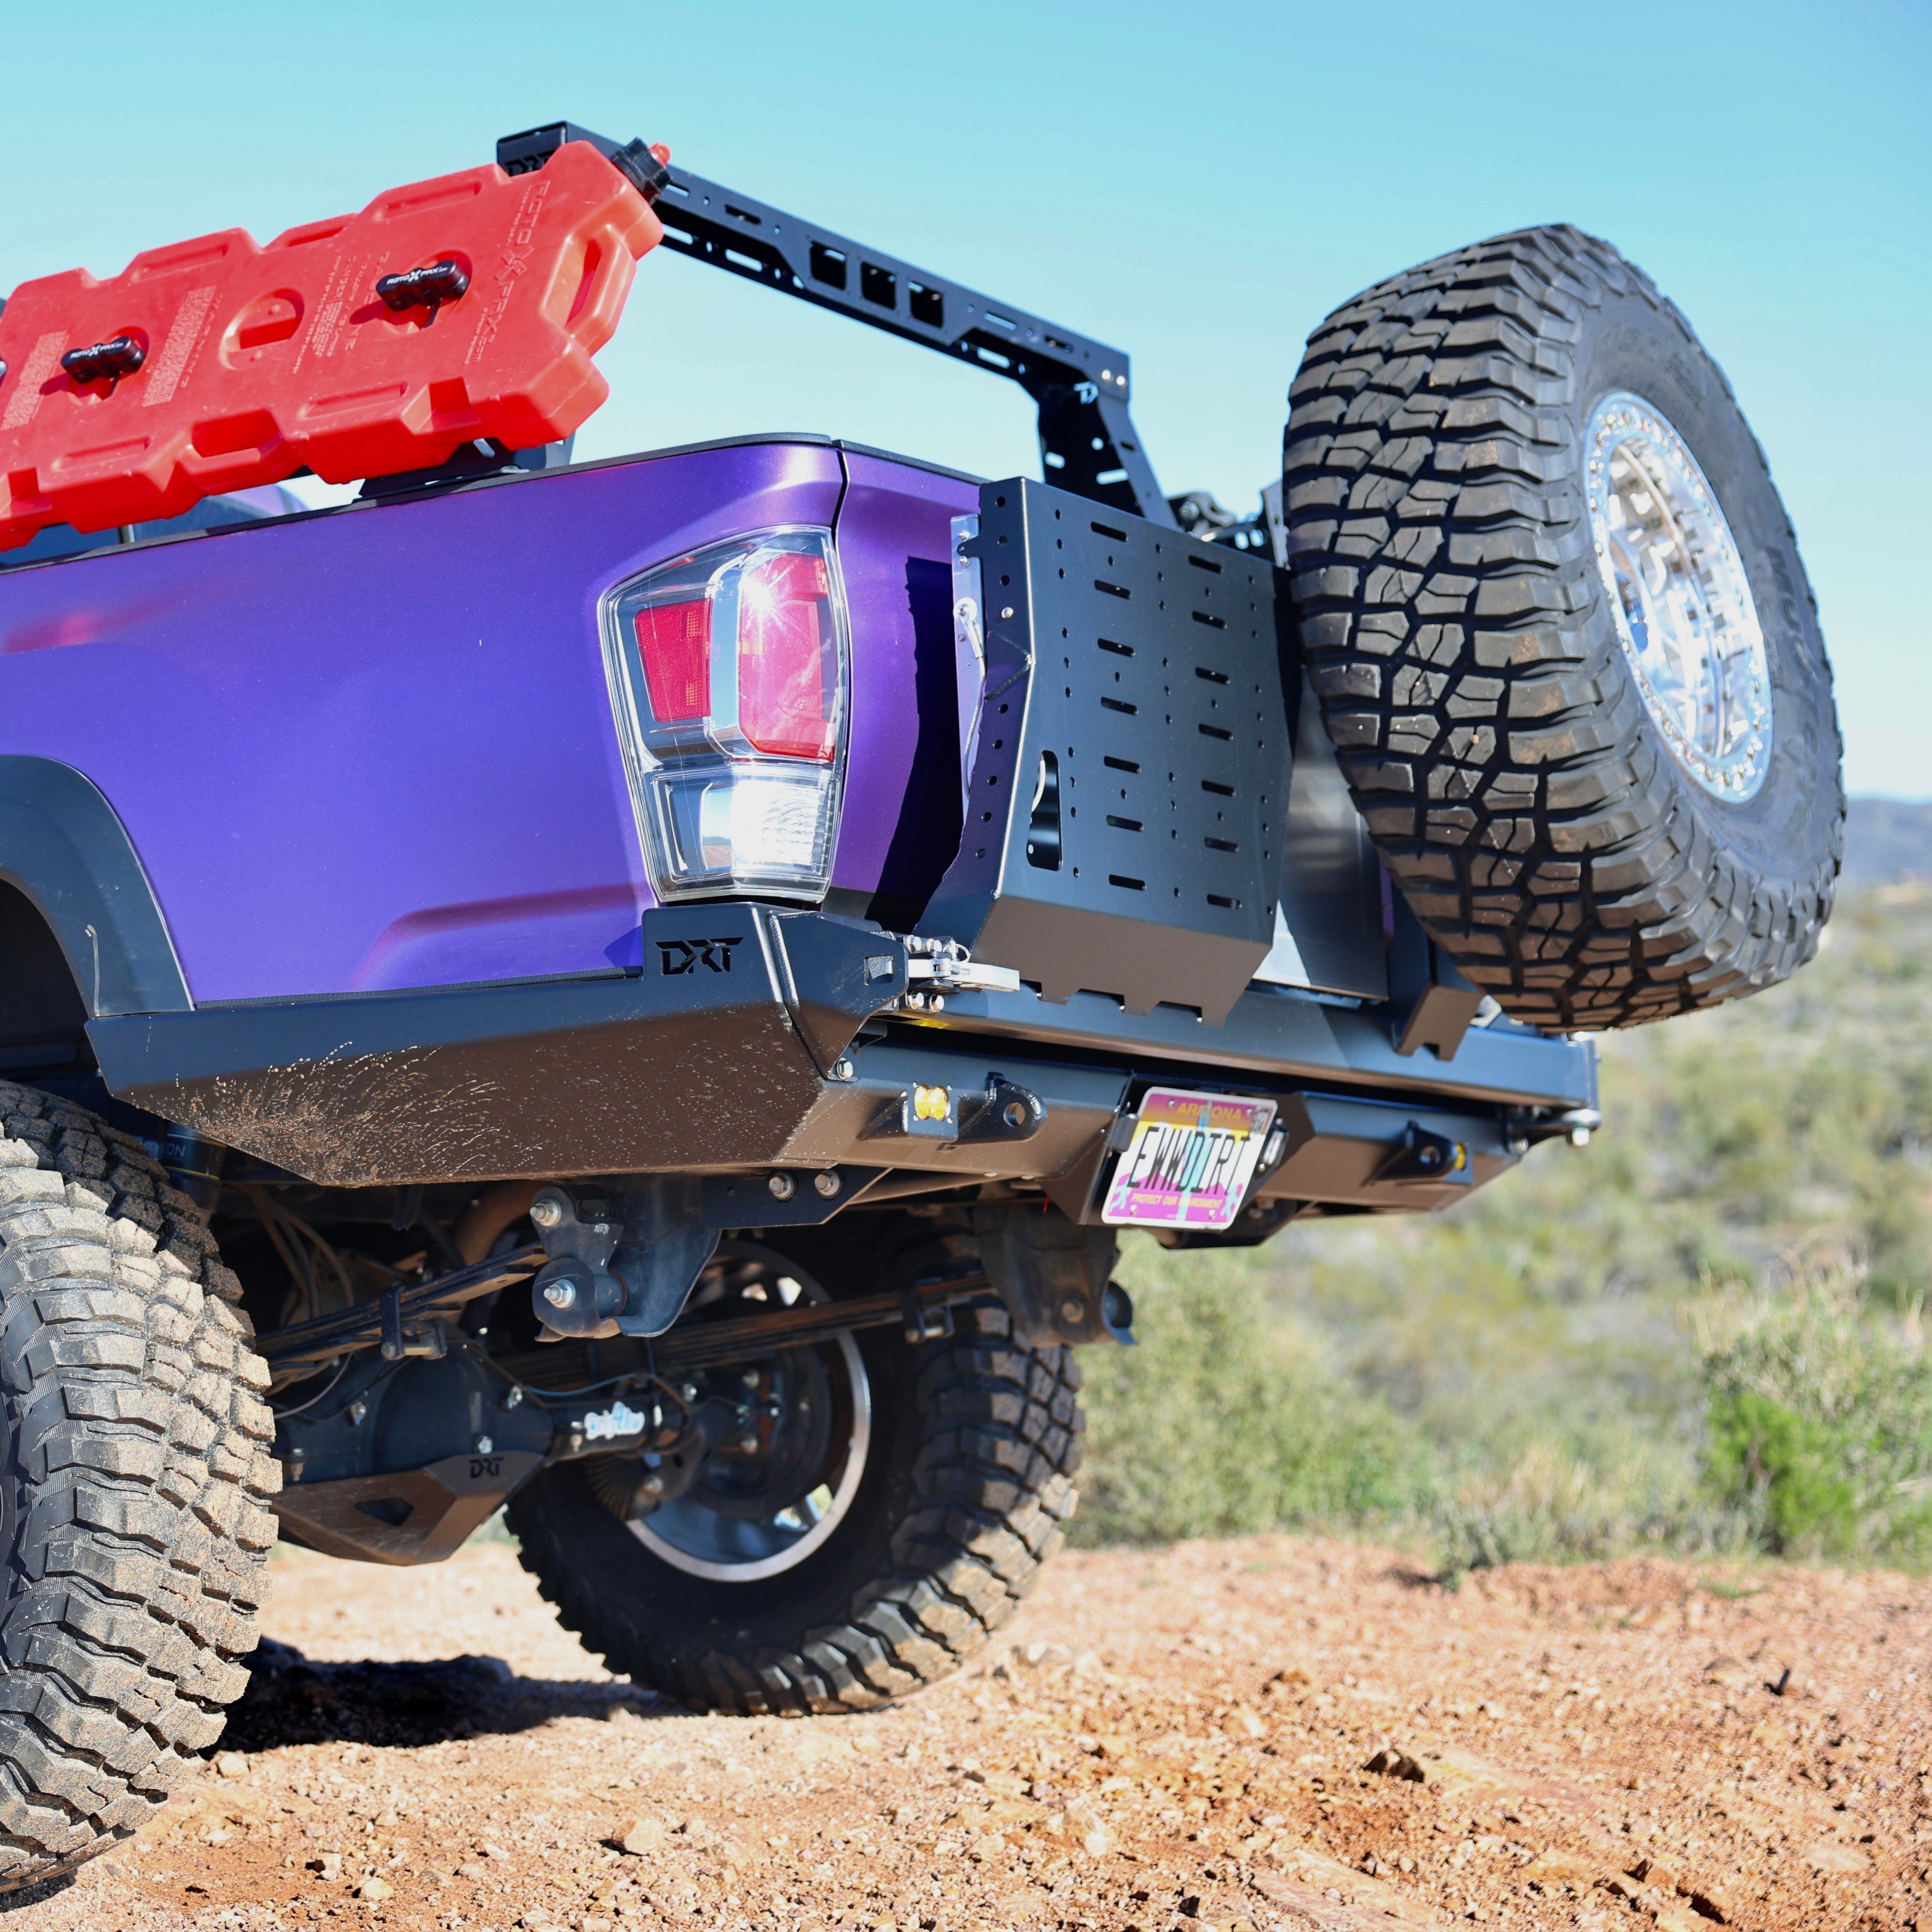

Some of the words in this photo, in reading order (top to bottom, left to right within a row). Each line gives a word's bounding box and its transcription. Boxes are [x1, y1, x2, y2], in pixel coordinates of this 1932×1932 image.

[654, 937, 744, 975] DRT
[1176, 1102, 1242, 1120] ARIZONA
[1126, 1125, 1251, 1195] EWWDIRT
[1131, 1193, 1163, 1205] PROTECT
[1178, 1197, 1223, 1209] EVIRONMENT
[469, 1456, 505, 1478] DRT
